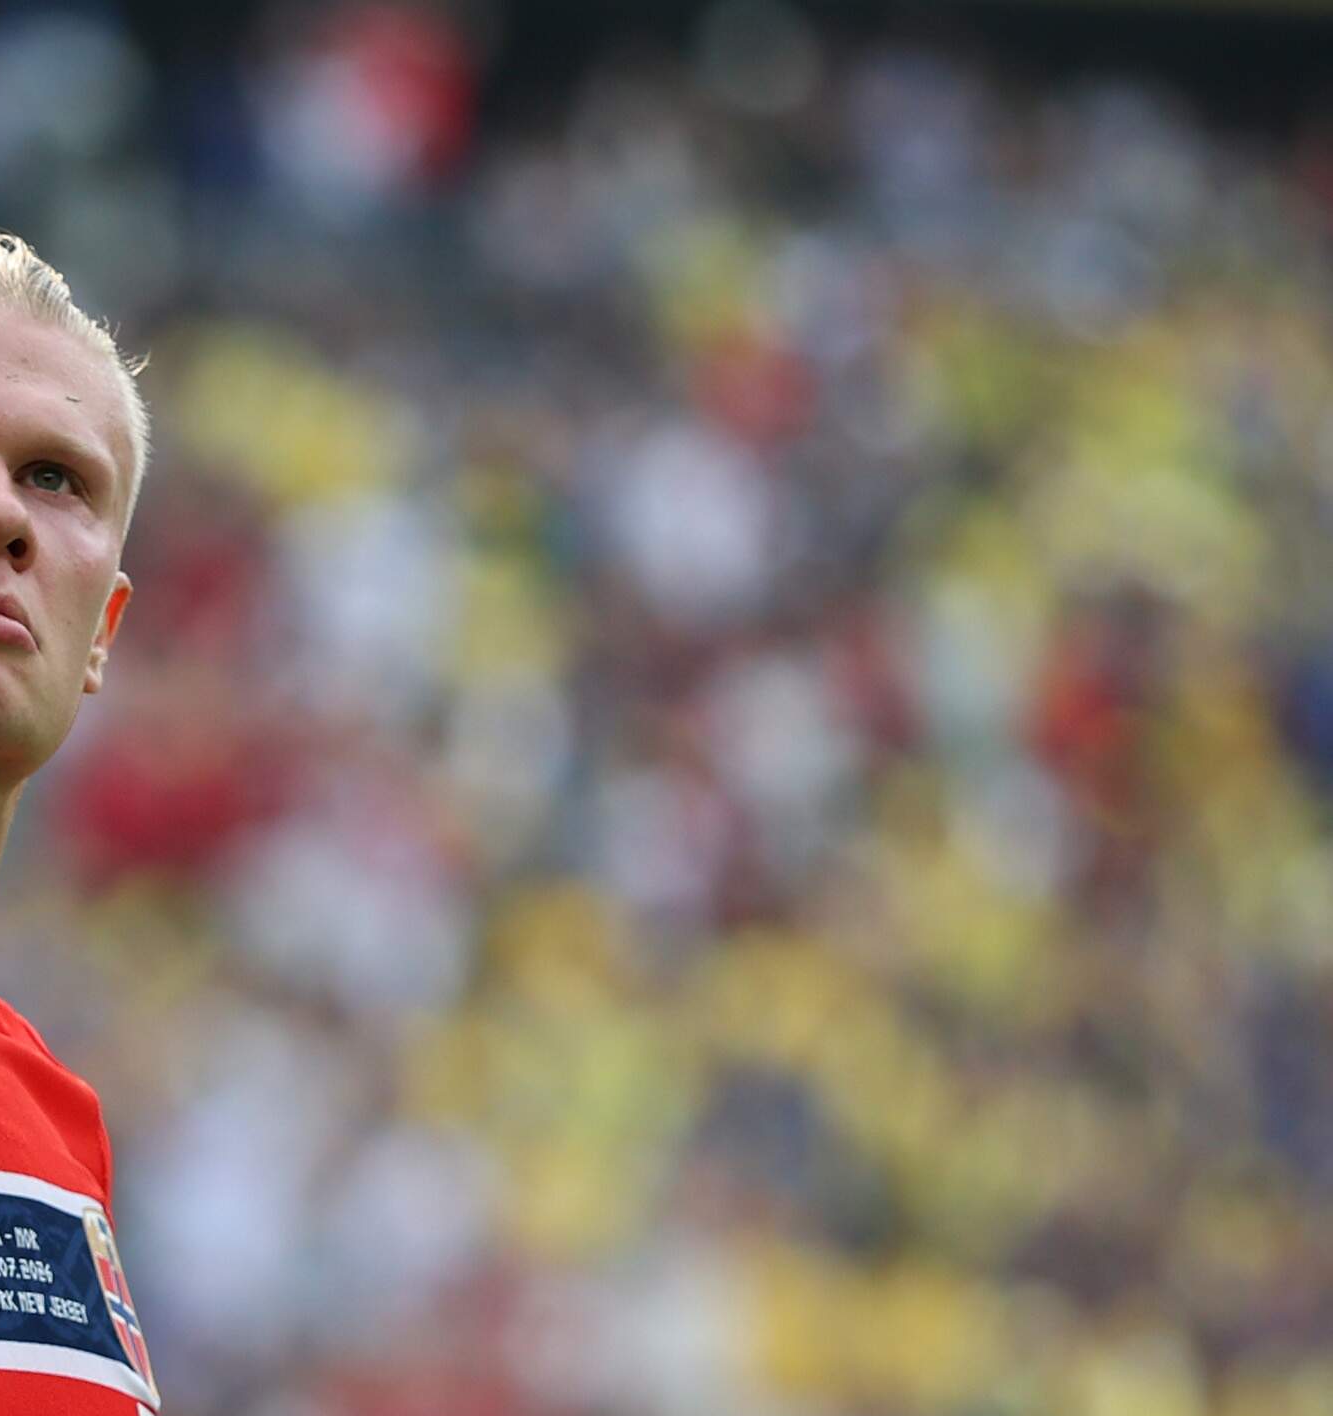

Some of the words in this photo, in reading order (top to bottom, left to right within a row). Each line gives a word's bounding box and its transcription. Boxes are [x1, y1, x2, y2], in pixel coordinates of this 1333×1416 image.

[14, 1226, 40, 1251] NOR
[17, 1291, 47, 1315] NEW
[48, 1295, 89, 1325] JERSEY
